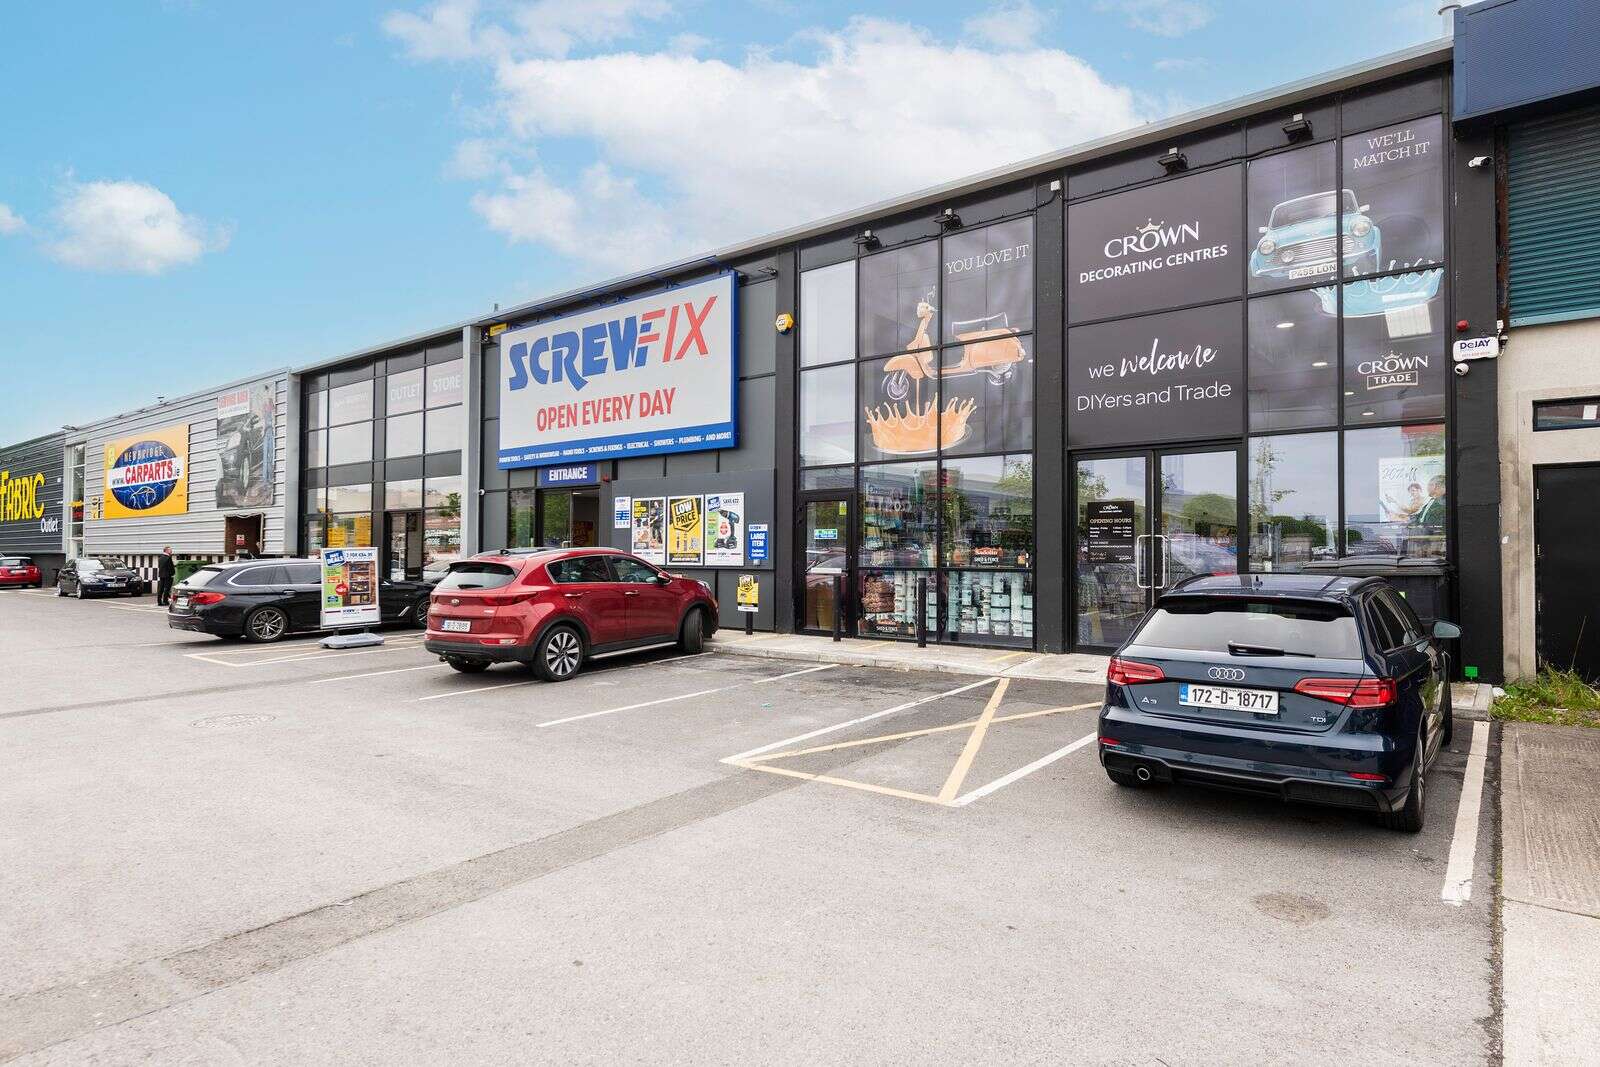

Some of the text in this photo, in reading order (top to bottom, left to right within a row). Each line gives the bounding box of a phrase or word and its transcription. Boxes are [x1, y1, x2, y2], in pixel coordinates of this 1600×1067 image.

[1367, 130, 1415, 149] WE'LL
[1353, 142, 1430, 169] MATCH IT
[1104, 221, 1199, 259] CROWN
[945, 244, 1029, 274] YOU LOVE IT
[1079, 244, 1228, 284] DECORATING CENTRES
[509, 295, 718, 391] SCREWFIX
[1088, 338, 1218, 379] we welcome
[1357, 355, 1429, 375] CROWN
[391, 375, 462, 401] OUTLET STORE
[1373, 373, 1412, 385] TRADE
[1077, 380, 1232, 411] DIYers and Trade
[536, 387, 676, 432] OPEN EVERY DAY
[548, 467, 588, 481] ENTRANCE
[675, 500, 693, 516] LOW
[675, 511, 697, 526] PRICE
[41, 517, 59, 533] Outlet
